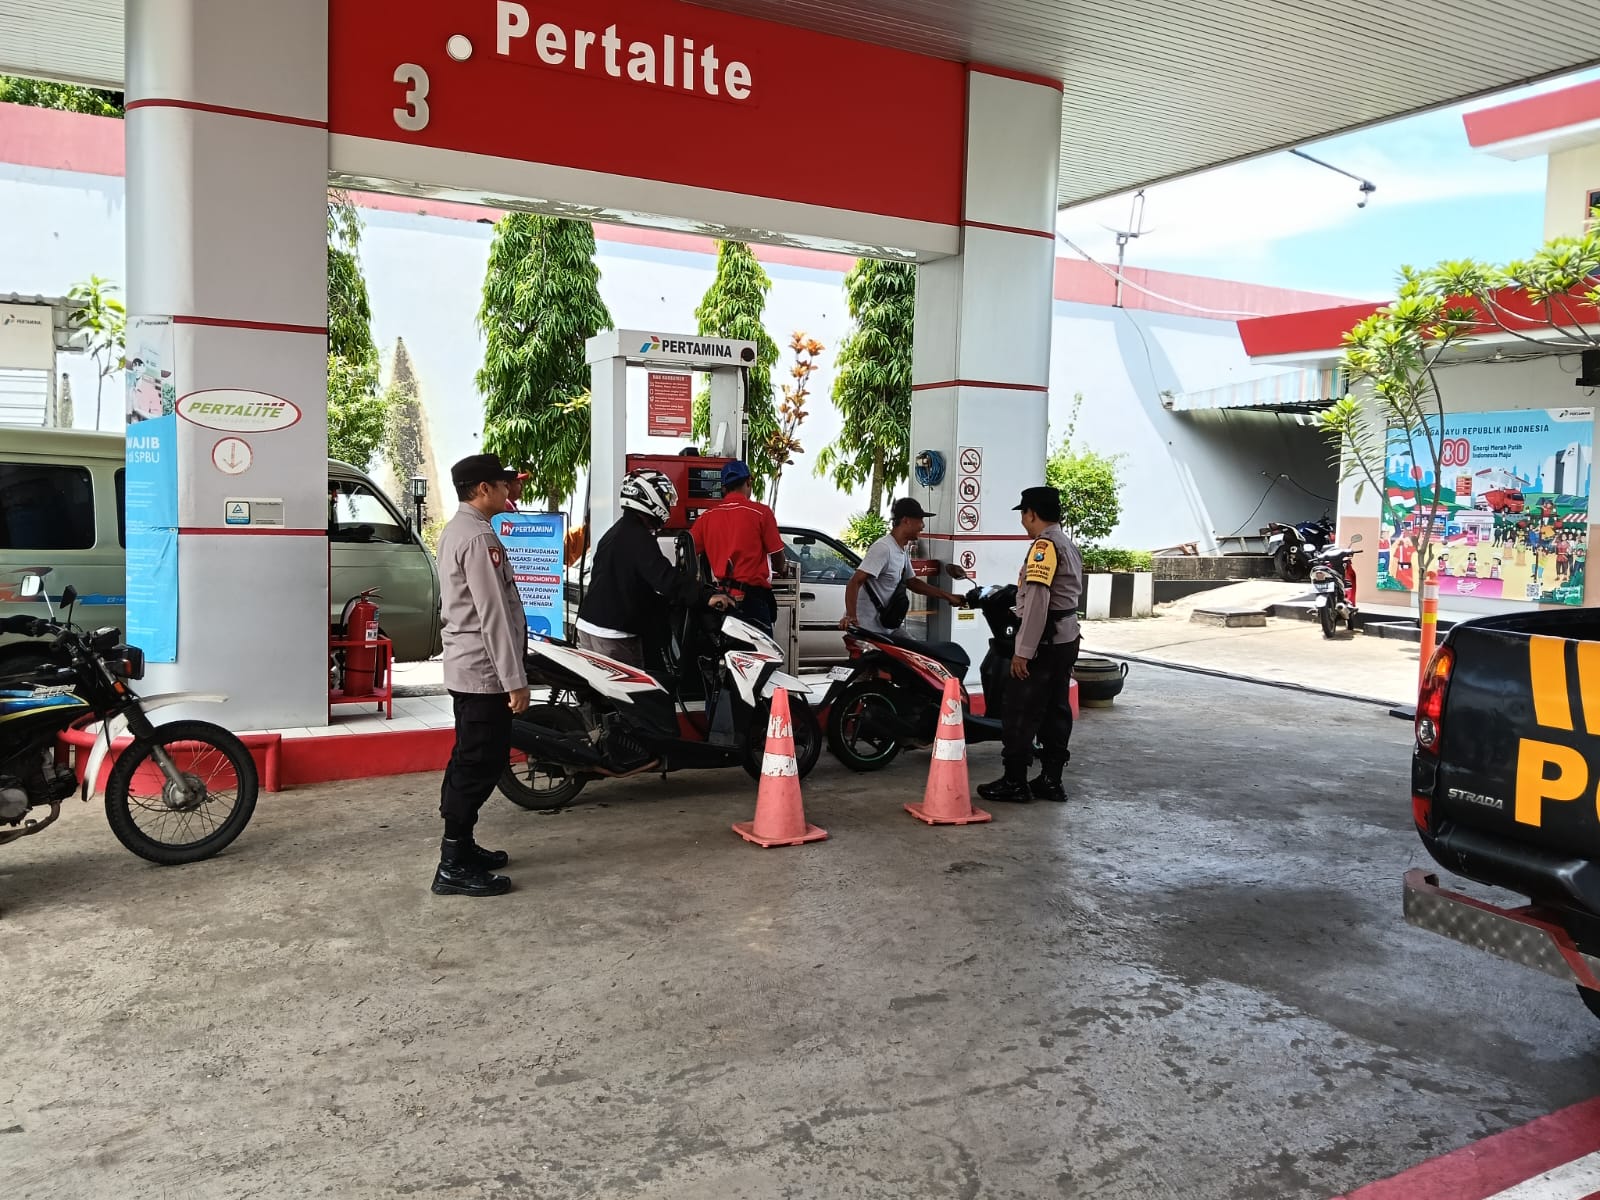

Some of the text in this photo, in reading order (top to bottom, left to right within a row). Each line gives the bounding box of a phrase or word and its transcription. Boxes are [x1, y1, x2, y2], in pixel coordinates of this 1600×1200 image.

[497, 0, 752, 100] Pertalite
[393, 63, 430, 131] 3
[661, 339, 732, 358] PERTAMINA
[187, 402, 284, 419] PERTALITE
[1417, 424, 1550, 437] DIGAAYU REPUBLIK INDONESIA
[134, 451, 160, 463] SPBU
[1515, 738, 1600, 828] P
[1448, 788, 1504, 810] STRADA
